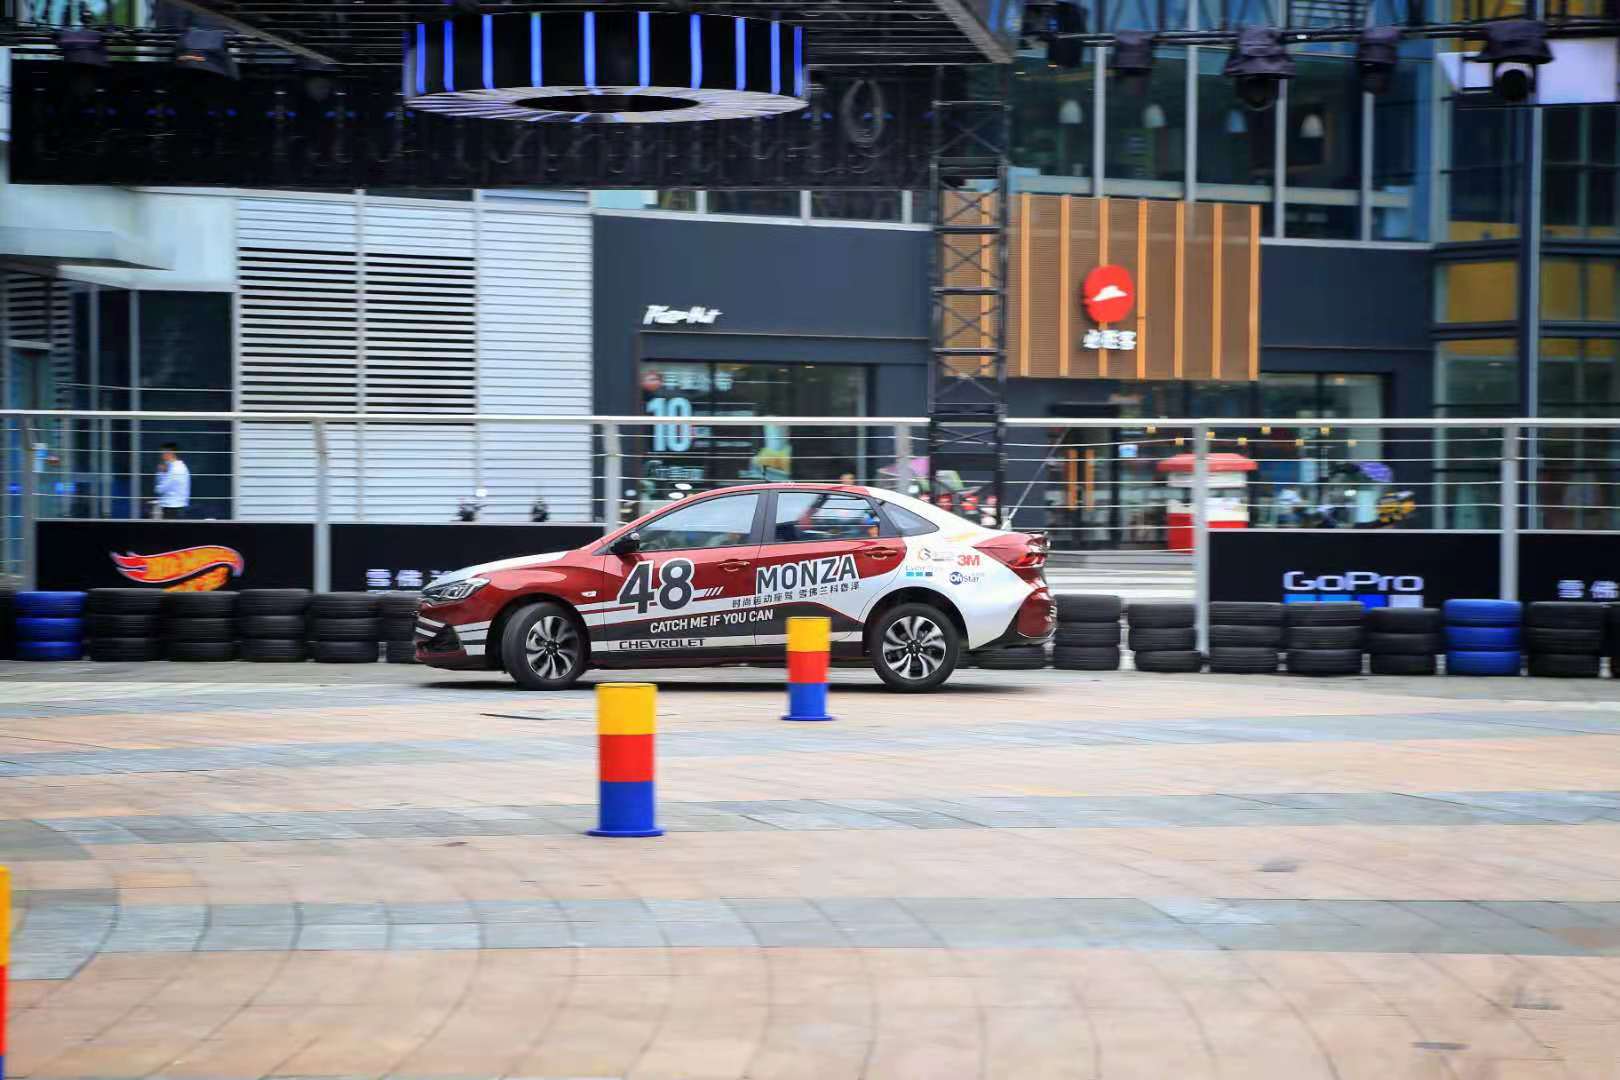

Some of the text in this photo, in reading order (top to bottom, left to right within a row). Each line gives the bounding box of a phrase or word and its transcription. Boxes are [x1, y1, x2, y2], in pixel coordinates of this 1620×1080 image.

[957, 554, 980, 567] 3M
[617, 557, 695, 614] 48
[756, 554, 860, 595] MONZA
[1282, 571, 1424, 592] GoPro
[650, 608, 774, 634] CATCH ME IF YOU CAN
[619, 638, 706, 650] CHEVROLET
